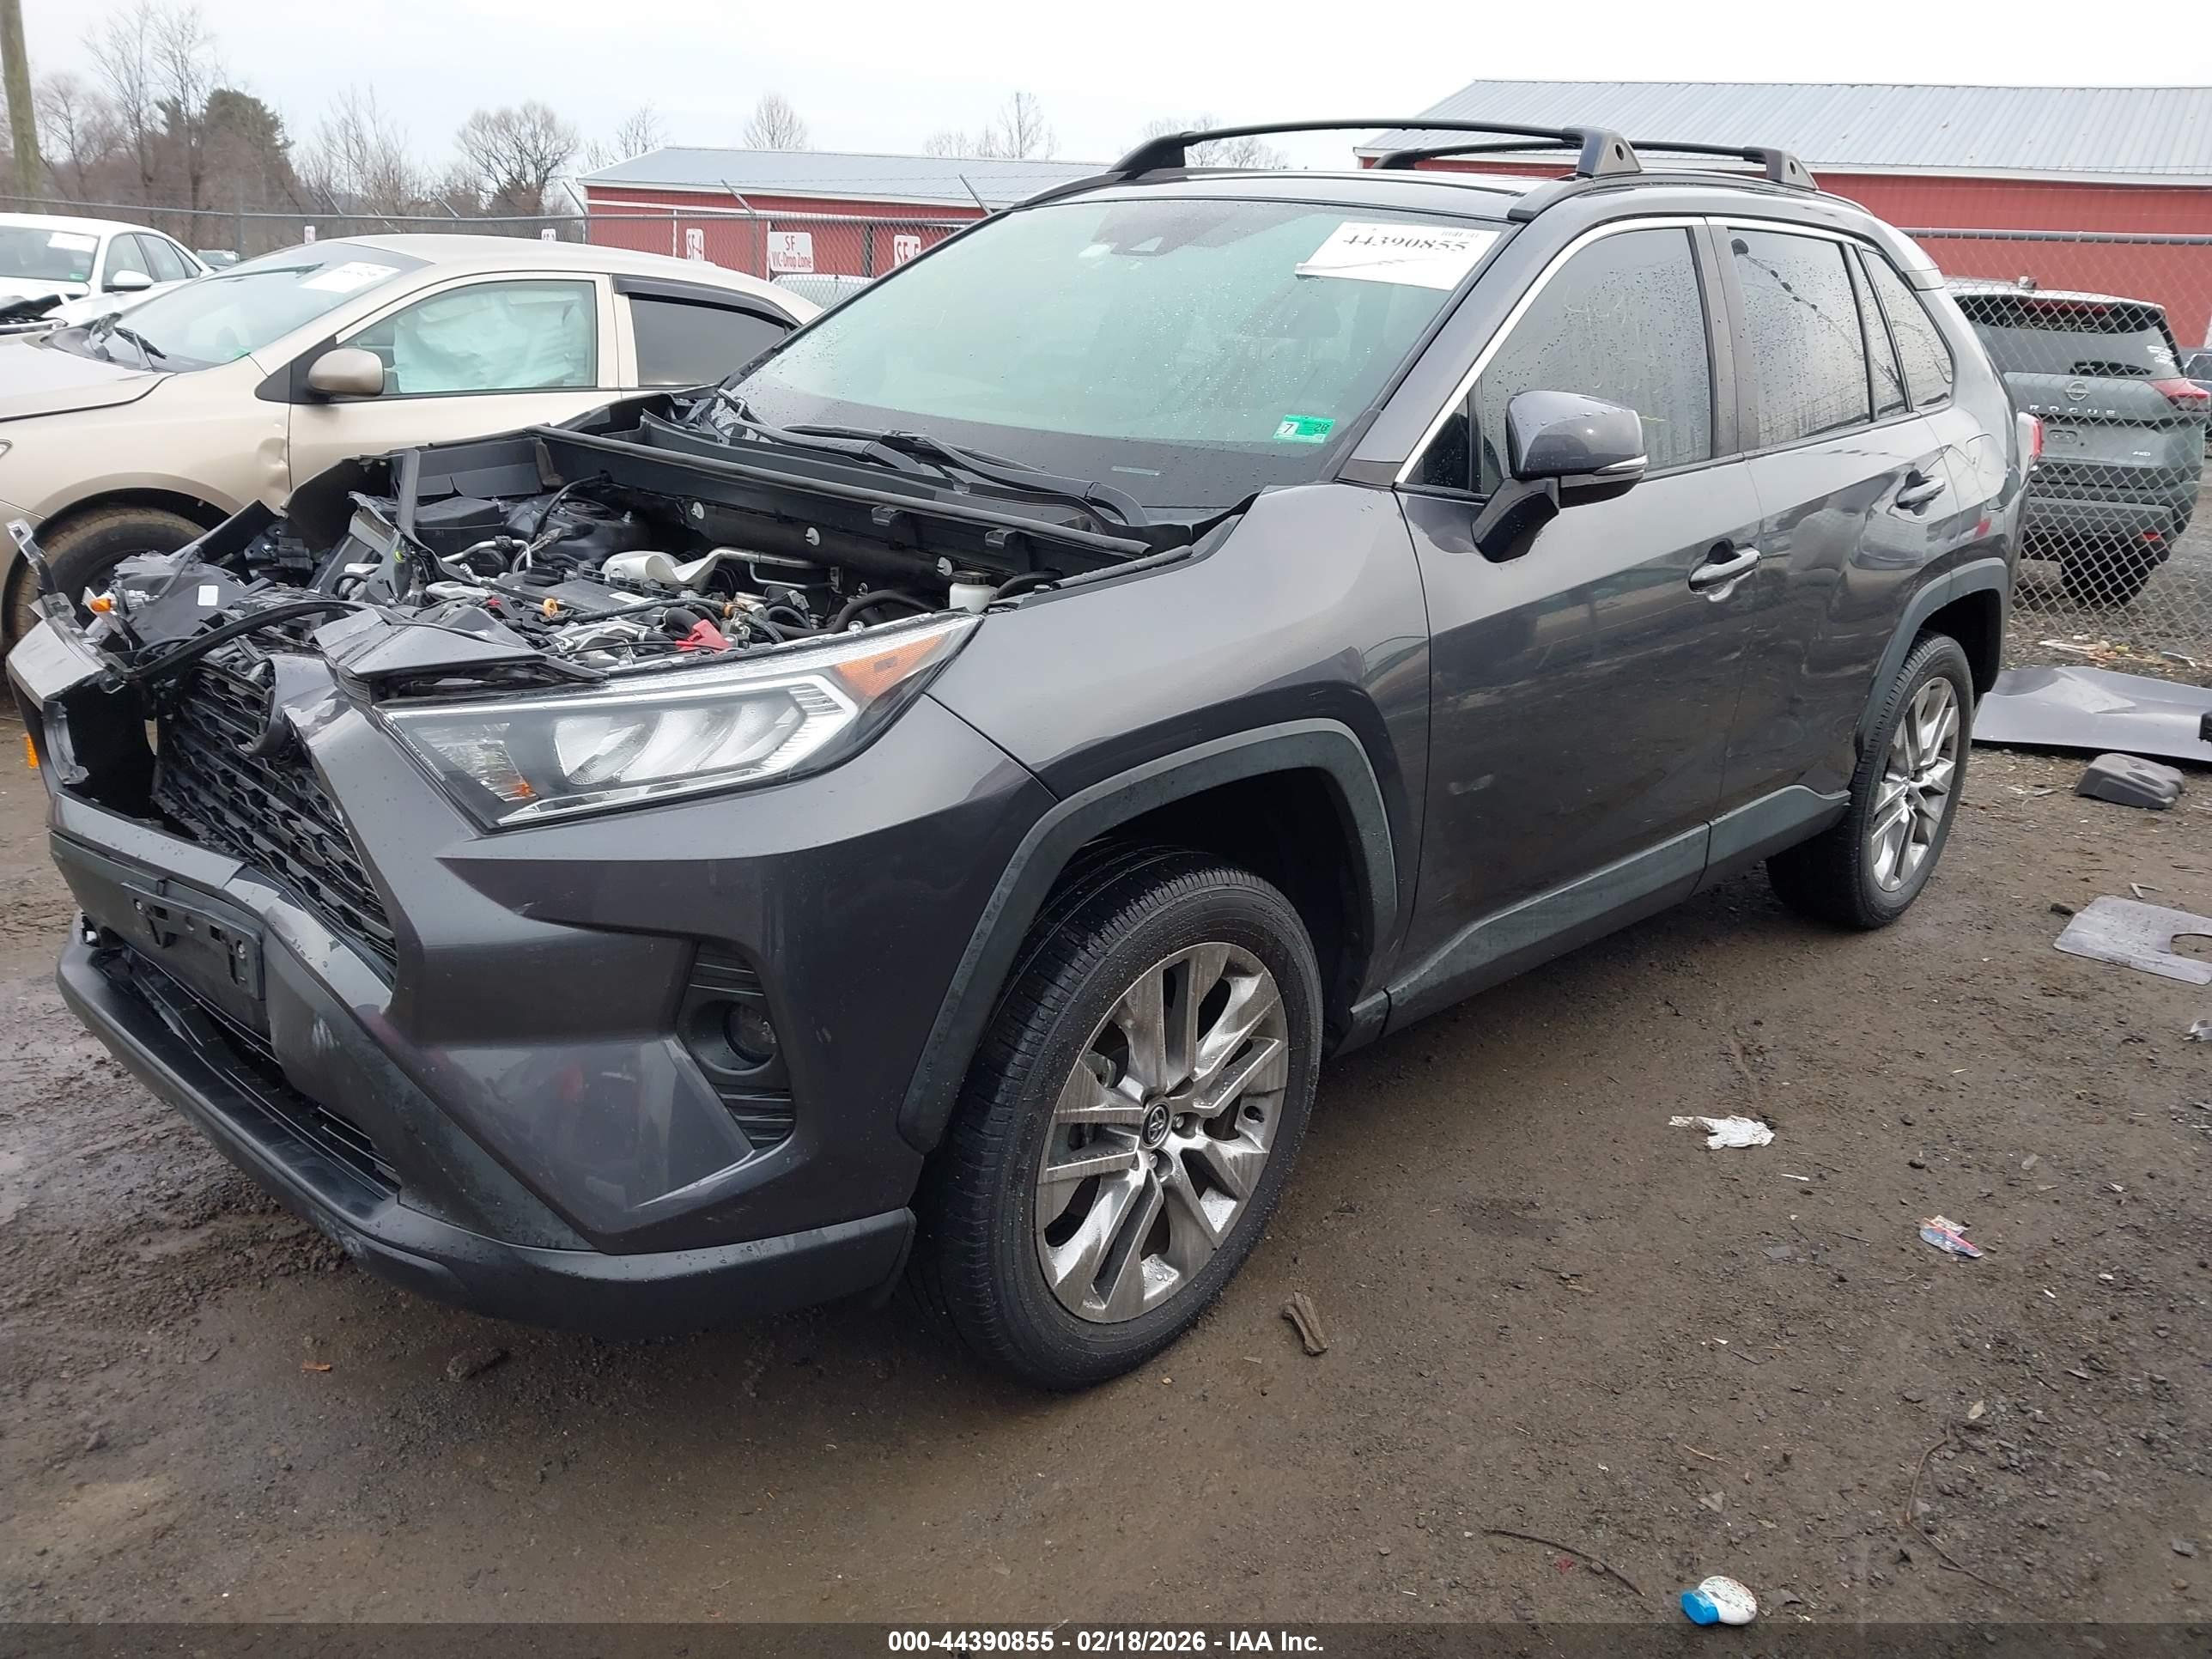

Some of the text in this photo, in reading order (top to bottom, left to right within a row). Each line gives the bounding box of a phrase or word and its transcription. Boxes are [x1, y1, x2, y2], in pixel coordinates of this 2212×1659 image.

[784, 234, 795, 251] SF
[1342, 234, 1470, 252] 44390855
[797, 252, 812, 268] Zone
[2029, 404, 2116, 416] ROGUE
[1284, 423, 1294, 434] 7
